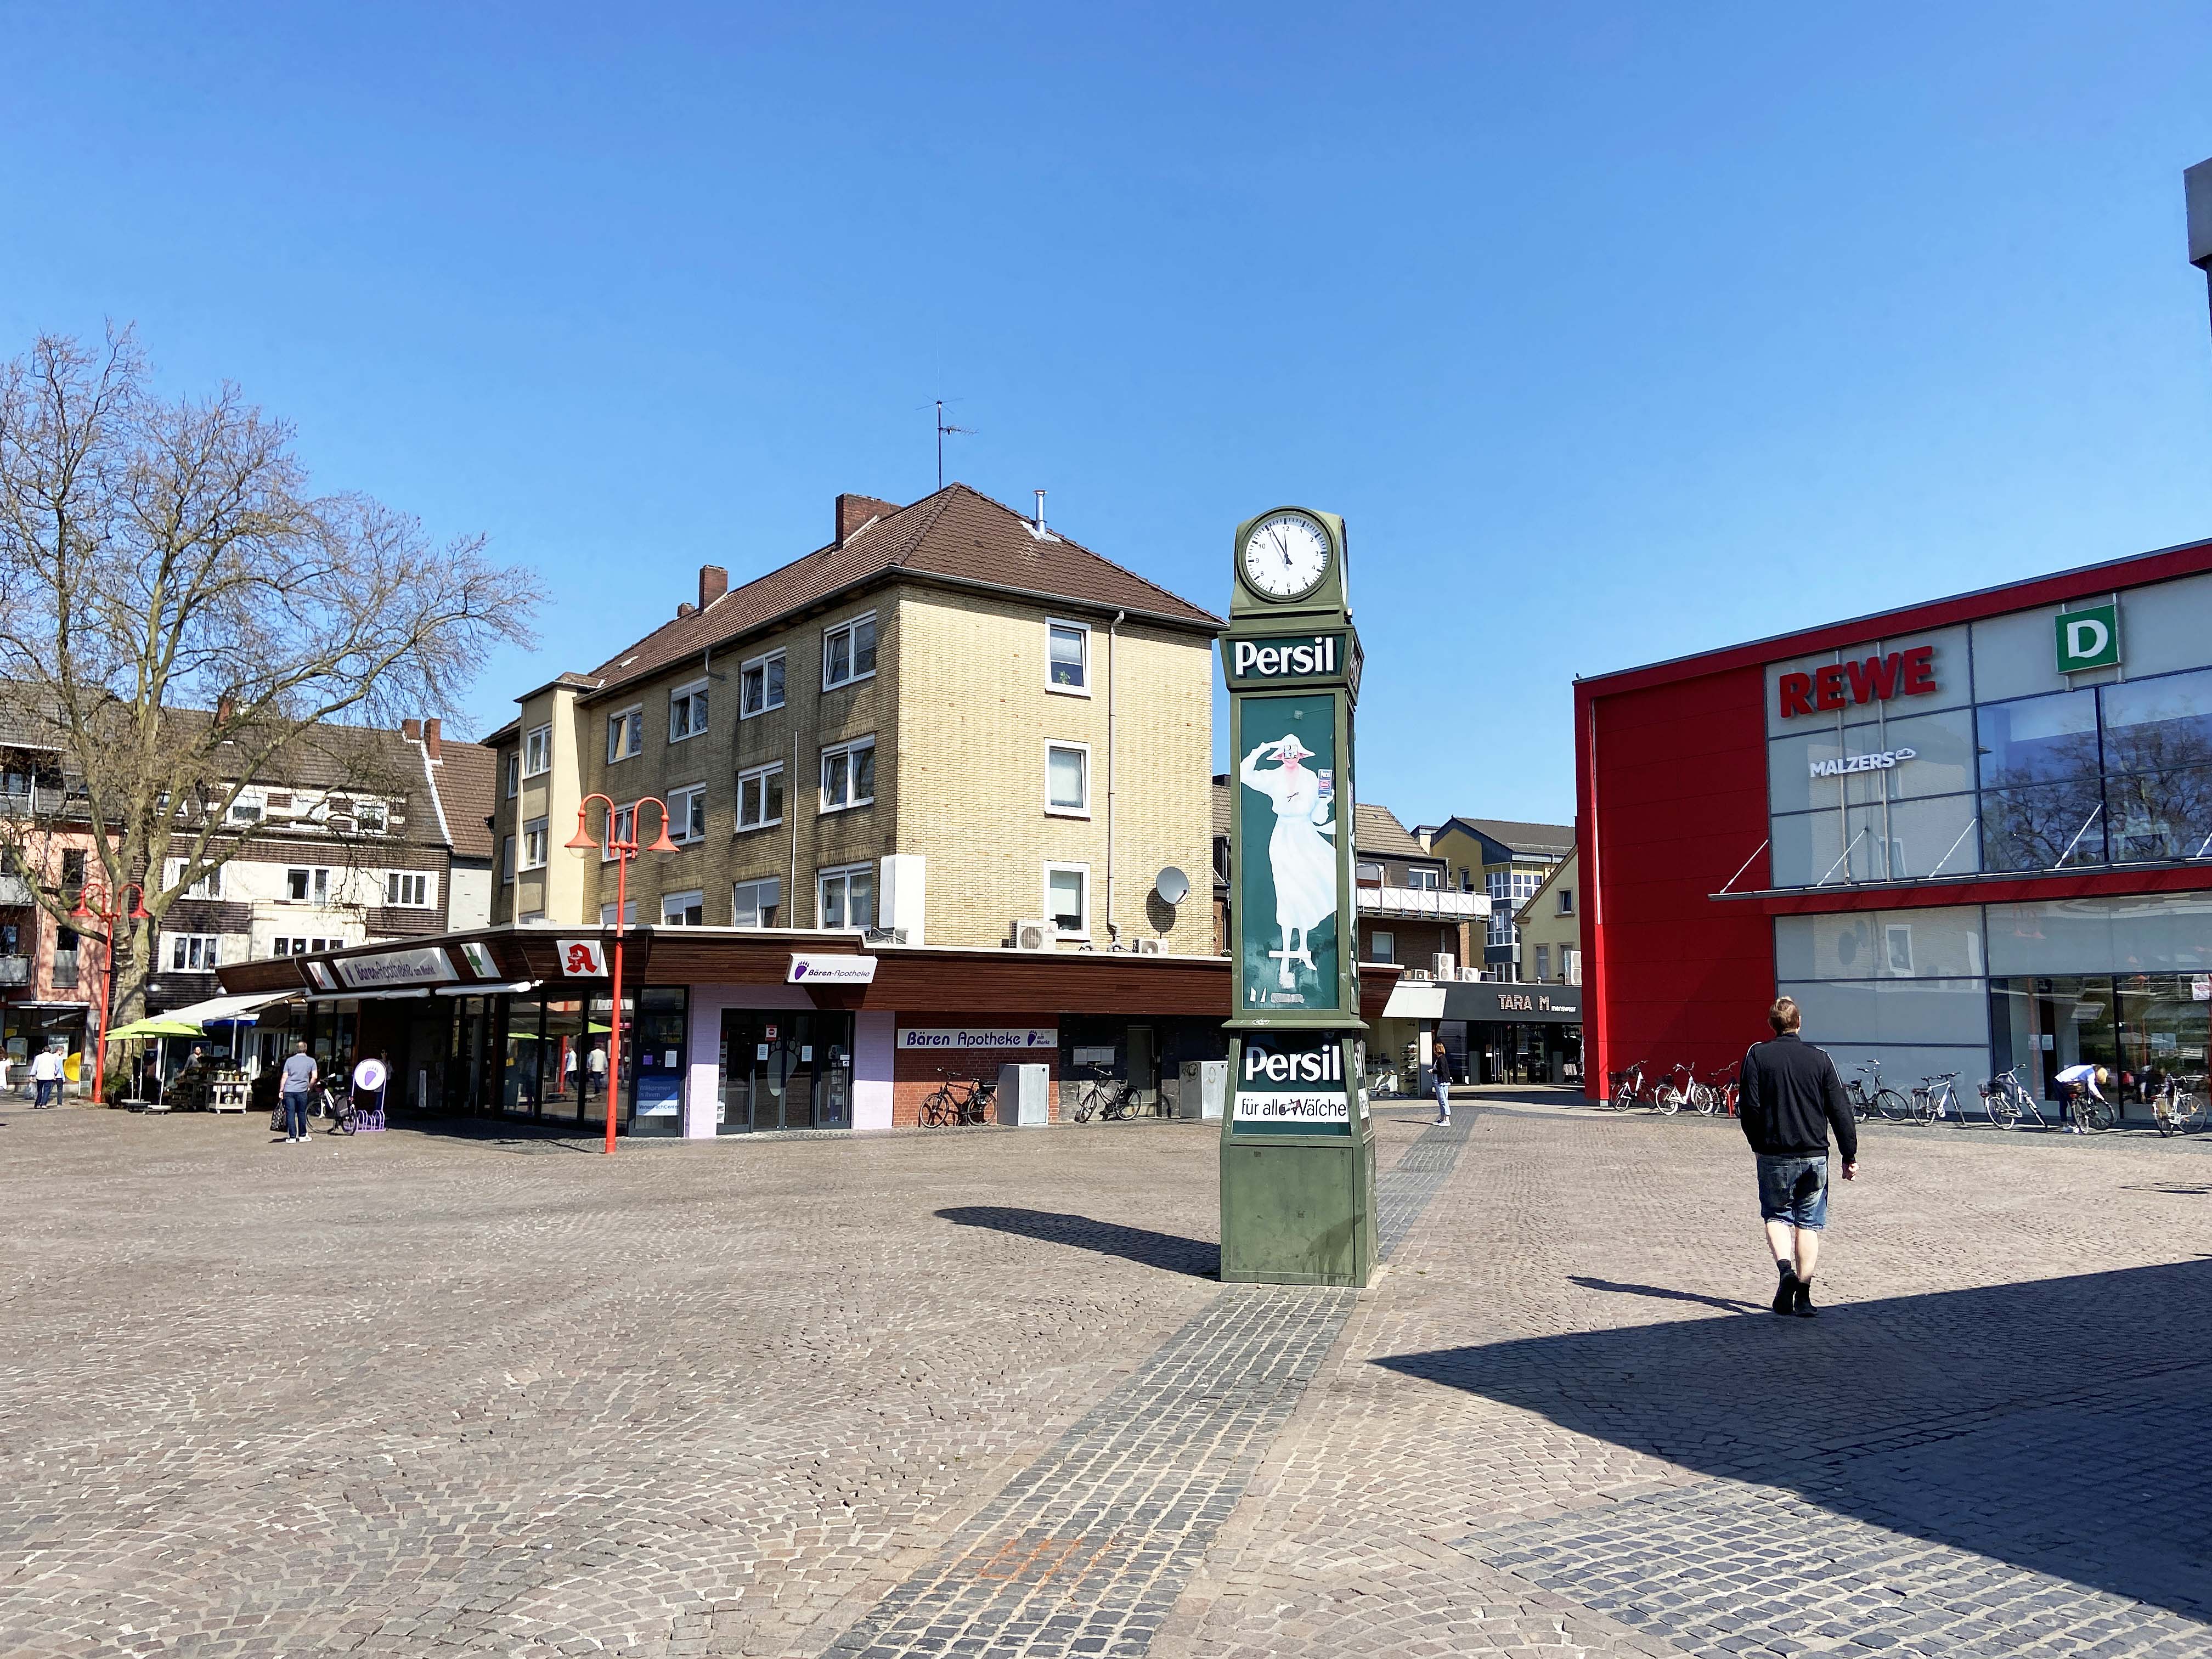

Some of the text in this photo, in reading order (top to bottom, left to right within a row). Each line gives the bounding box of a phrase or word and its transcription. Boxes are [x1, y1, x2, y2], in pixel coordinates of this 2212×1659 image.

[2067, 619, 2108, 658] D
[1235, 636, 1334, 675] Persil
[1779, 645, 1936, 719] REWE
[1810, 752, 1895, 777] MALZERS
[566, 943, 597, 974] A
[808, 969, 870, 978] Bären-Apotheke
[1498, 994, 1532, 1011] TARA
[1539, 996, 1550, 1011] M
[907, 1031, 1021, 1047] Bären Apotheke
[1245, 1044, 1340, 1081] Persil
[1242, 1098, 1260, 1115] für
